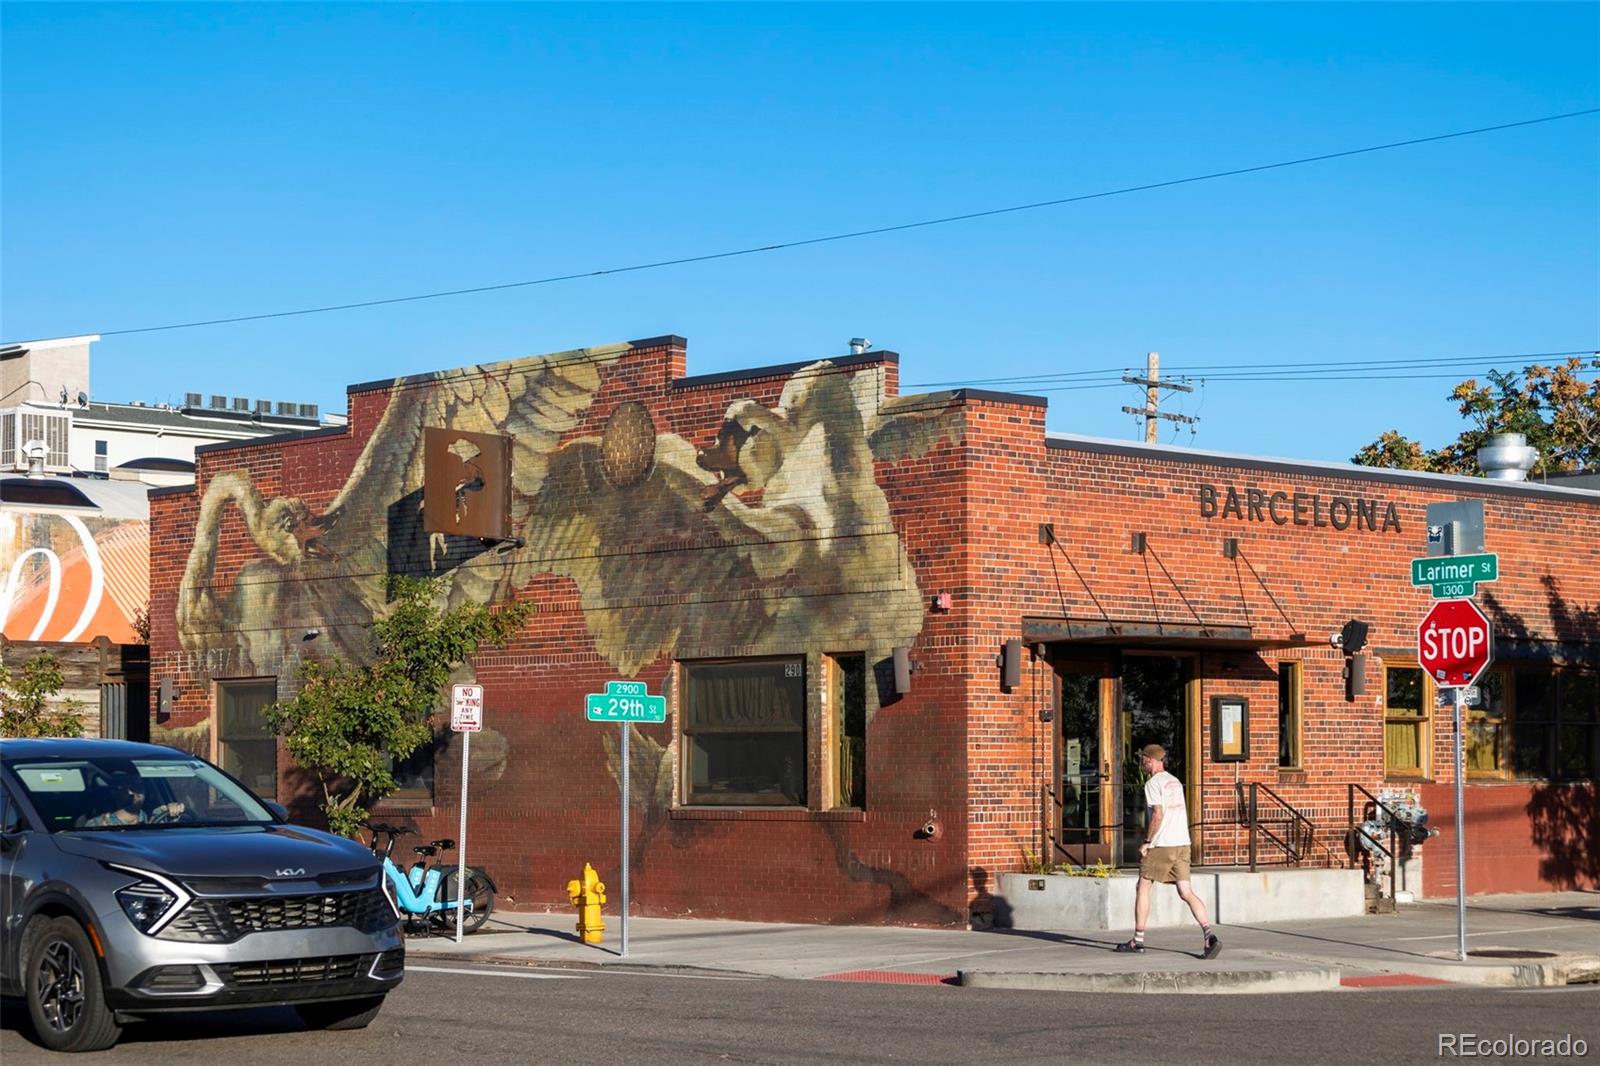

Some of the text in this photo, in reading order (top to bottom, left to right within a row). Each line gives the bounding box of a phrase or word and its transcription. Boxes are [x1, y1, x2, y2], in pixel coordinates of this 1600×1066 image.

[1200, 483, 1402, 533] BARCELONA
[1418, 562, 1492, 582] Larimer St
[1442, 584, 1464, 596] 1300
[1423, 626, 1485, 661] STOP
[462, 688, 473, 697] NO
[616, 684, 639, 694] 2900
[608, 698, 657, 717] 29th St
[275, 867, 306, 877] KIA
